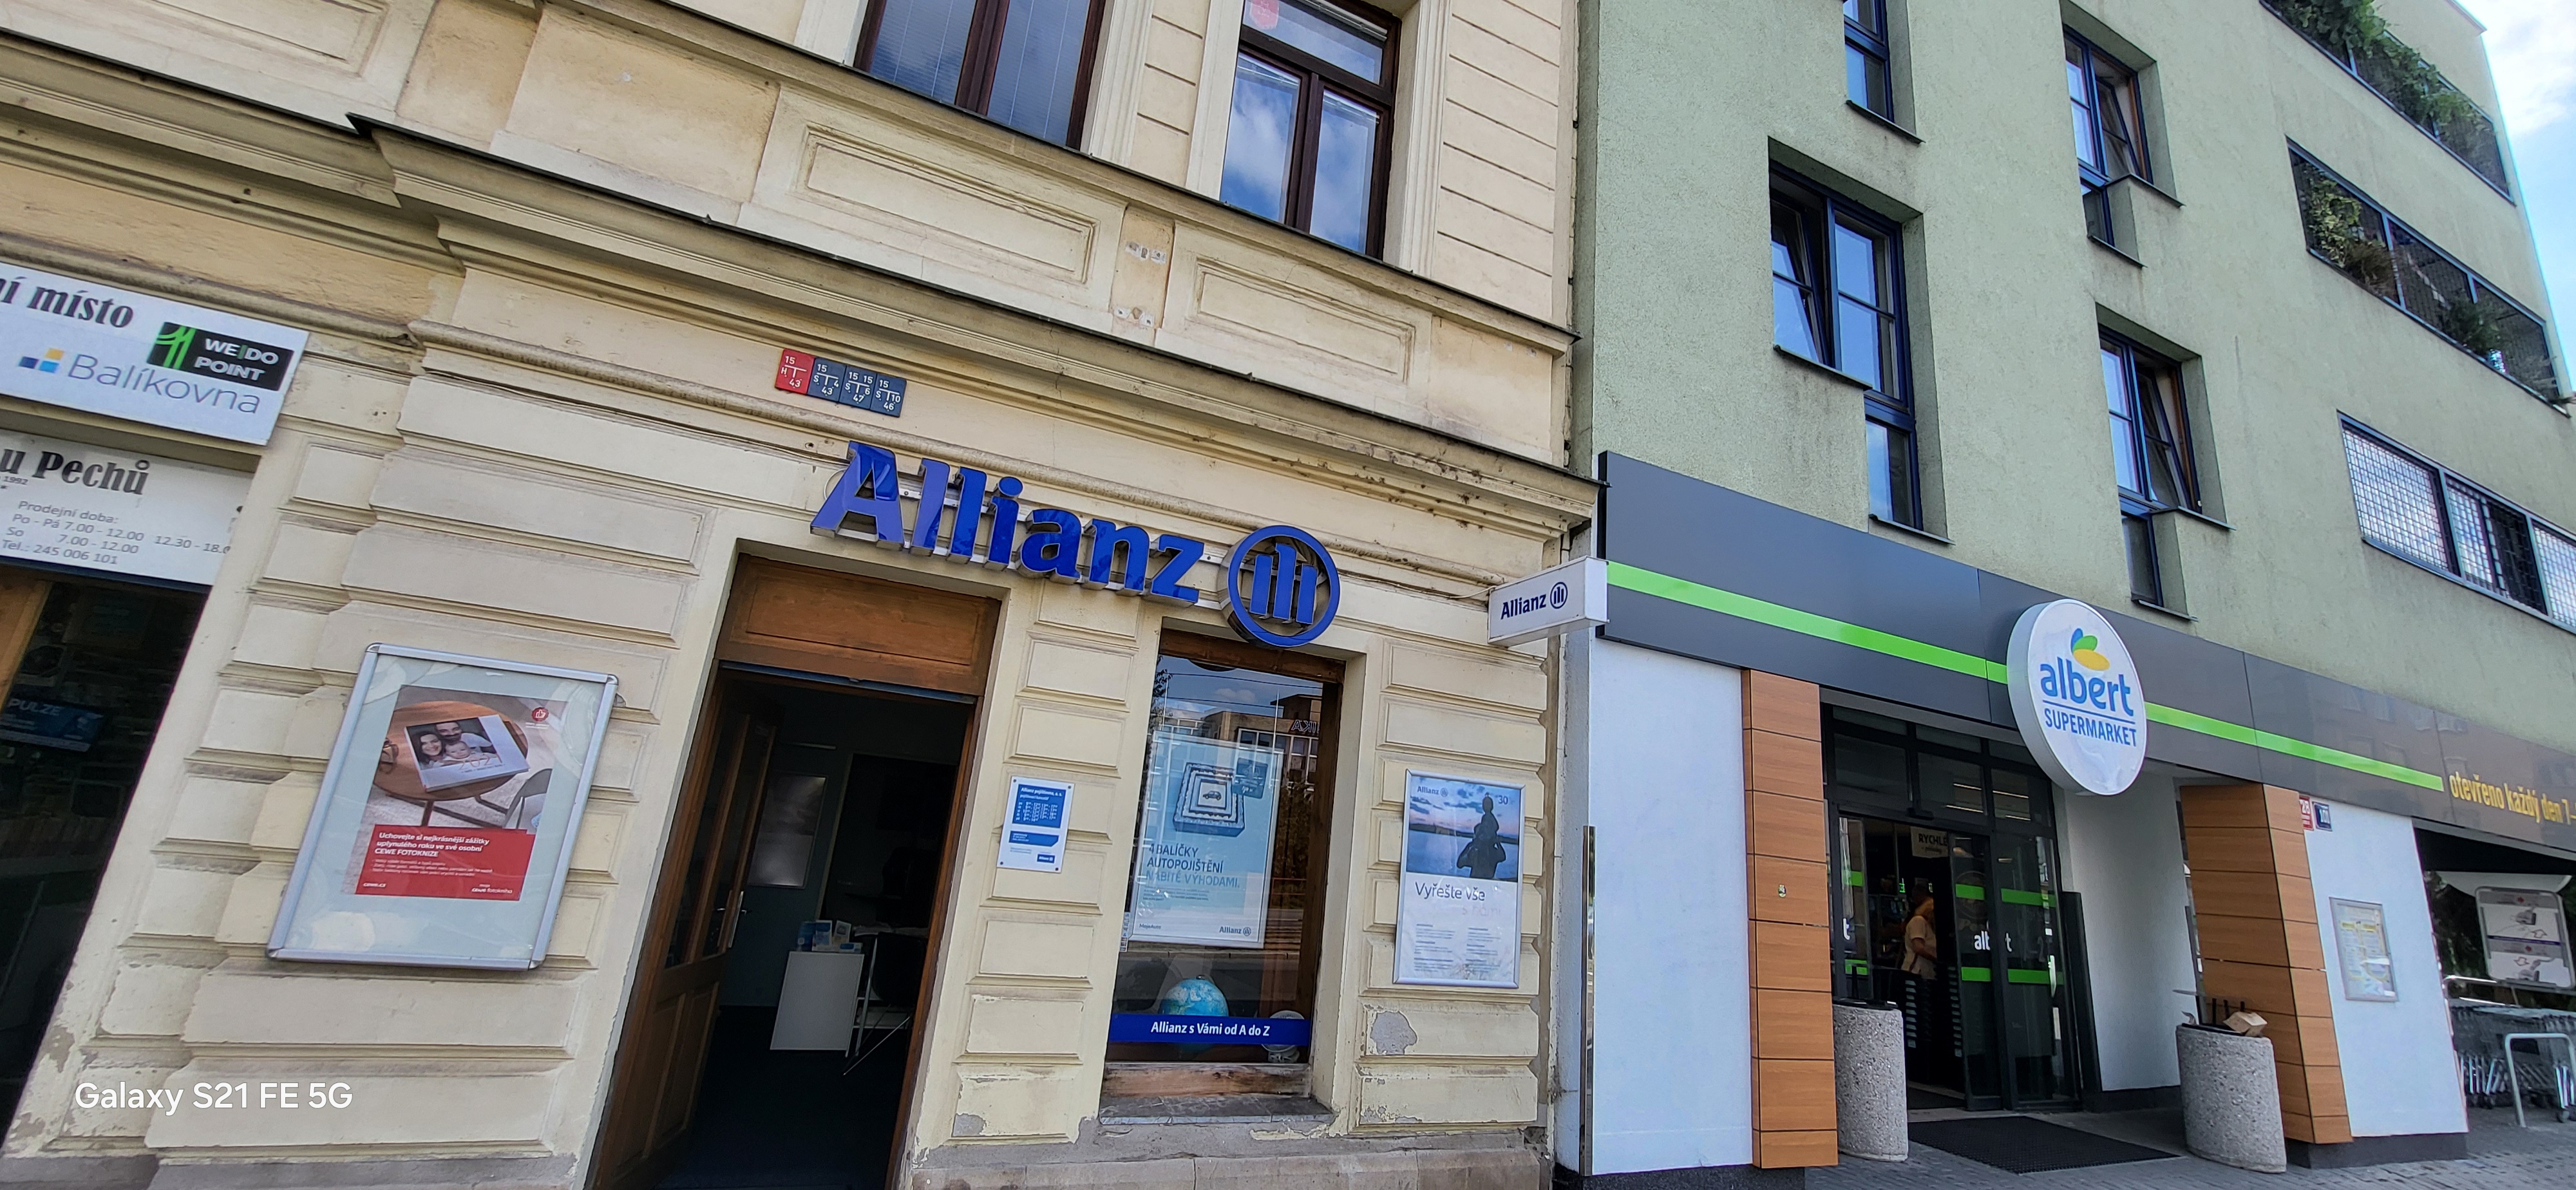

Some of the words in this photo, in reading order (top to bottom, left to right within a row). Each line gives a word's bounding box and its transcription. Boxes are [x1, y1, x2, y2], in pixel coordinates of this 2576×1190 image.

[26, 287, 133, 328] místo
[194, 356, 265, 381] POINT
[785, 355, 796, 365] 15
[817, 364, 828, 372] 15
[68, 354, 260, 413] Balíkovna
[848, 372, 859, 381] 15
[864, 375, 873, 384] 15
[879, 379, 889, 388] 15
[0, 449, 26, 474] u
[32, 450, 151, 495] Pechů
[4, 476, 28, 485] 1992
[18, 500, 79, 517] Prodejní
[79, 511, 119, 524] doba:
[810, 440, 1205, 604] Allianz
[6, 526, 24, 536] So
[59, 534, 88, 546] 7.00
[100, 541, 139, 554] 12.00
[12, 513, 30, 524] Po
[43, 518, 60, 529] Pá
[64, 522, 94, 534] 7.00
[106, 528, 144, 541] 12.00
[155, 535, 192, 548] 12.30
[33, 544, 60, 556] 245
[63, 549, 90, 560] 006
[93, 554, 118, 565] 101
[1500, 593, 1546, 619] Allianz
[2040, 657, 2134, 717] albert
[2044, 708, 2137, 747] SUPERMARKET
[1417, 786, 1439, 795] Allianz
[1498, 795, 1508, 805] 30
[2449, 771, 2505, 809] otevřeno
[2503, 782, 2541, 824] každý
[2541, 793, 2563, 823] den
[397, 849, 439, 857] FOTOKNIZE
[1156, 842, 1198, 858] BALÍČKY
[1147, 857, 1224, 873] AUTOPOJIŠTĚNÍ
[1184, 872, 1240, 888] VÝHODAMI.
[1415, 882, 1463, 900] Vyřešte
[1466, 887, 1485, 901] vše
[1219, 926, 1242, 934] Allianz
[1151, 1021, 1187, 1034] Allianz
[1189, 1025, 1195, 1034] s
[1197, 1022, 1222, 1035] Vámi
[1224, 1024, 1237, 1035] od
[1238, 1025, 1247, 1035] A
[1249, 1024, 1261, 1036] do
[1262, 1025, 1271, 1036] Z
